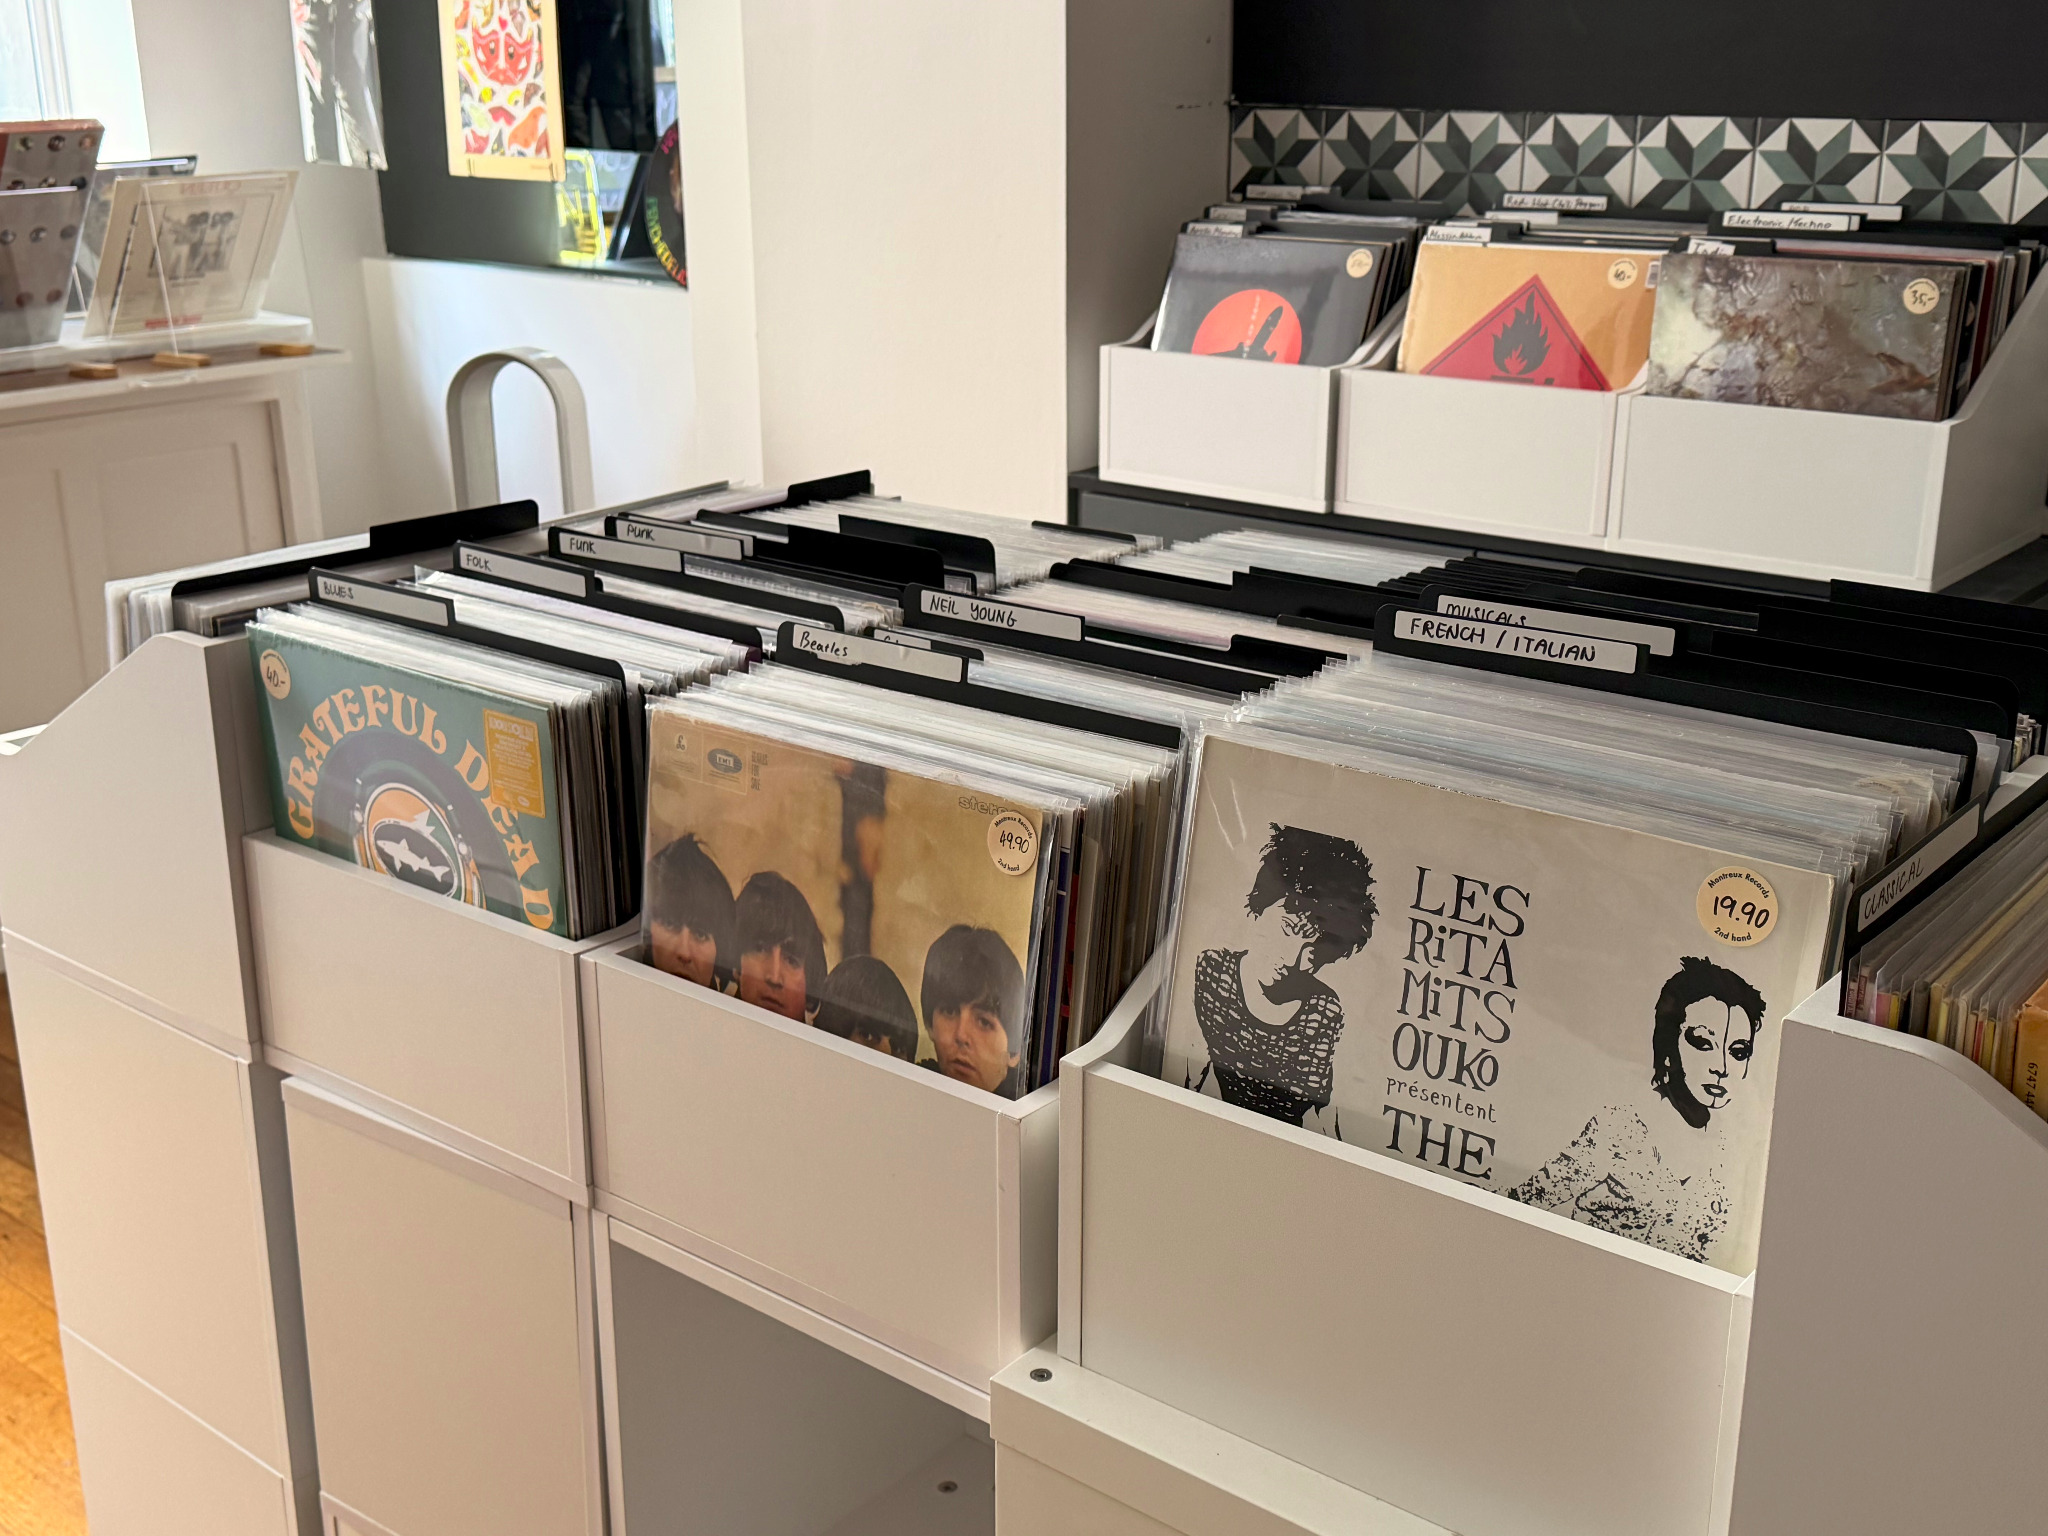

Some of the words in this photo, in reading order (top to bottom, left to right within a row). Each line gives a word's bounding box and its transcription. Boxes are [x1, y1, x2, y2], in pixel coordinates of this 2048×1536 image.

[465, 554, 493, 572] FOLK
[323, 580, 355, 600] BLUES
[970, 601, 1019, 628] YOUNG
[799, 629, 849, 658] Beatles
[1409, 617, 1486, 645] FRENCH
[1495, 629, 1508, 650] /
[1513, 635, 1597, 663] ITALIAN
[287, 684, 448, 840] GRATEFUL
[453, 738, 554, 930] DEAD
[999, 829, 1030, 854] 49.90
[997, 858, 1007, 869] 2nd
[1707, 872, 1743, 889] Montreux
[1744, 873, 1770, 899] Records
[1863, 857, 1925, 921] CLASSICAL
[1409, 865, 1531, 937] LES
[1713, 895, 1770, 929] 19.90
[1713, 926, 1730, 940] 2nd
[1731, 931, 1752, 942] hand
[2026, 1062, 2039, 1090] 6747
[1386, 1076, 1498, 1124] présentent
[1382, 1103, 1496, 1181] THE
